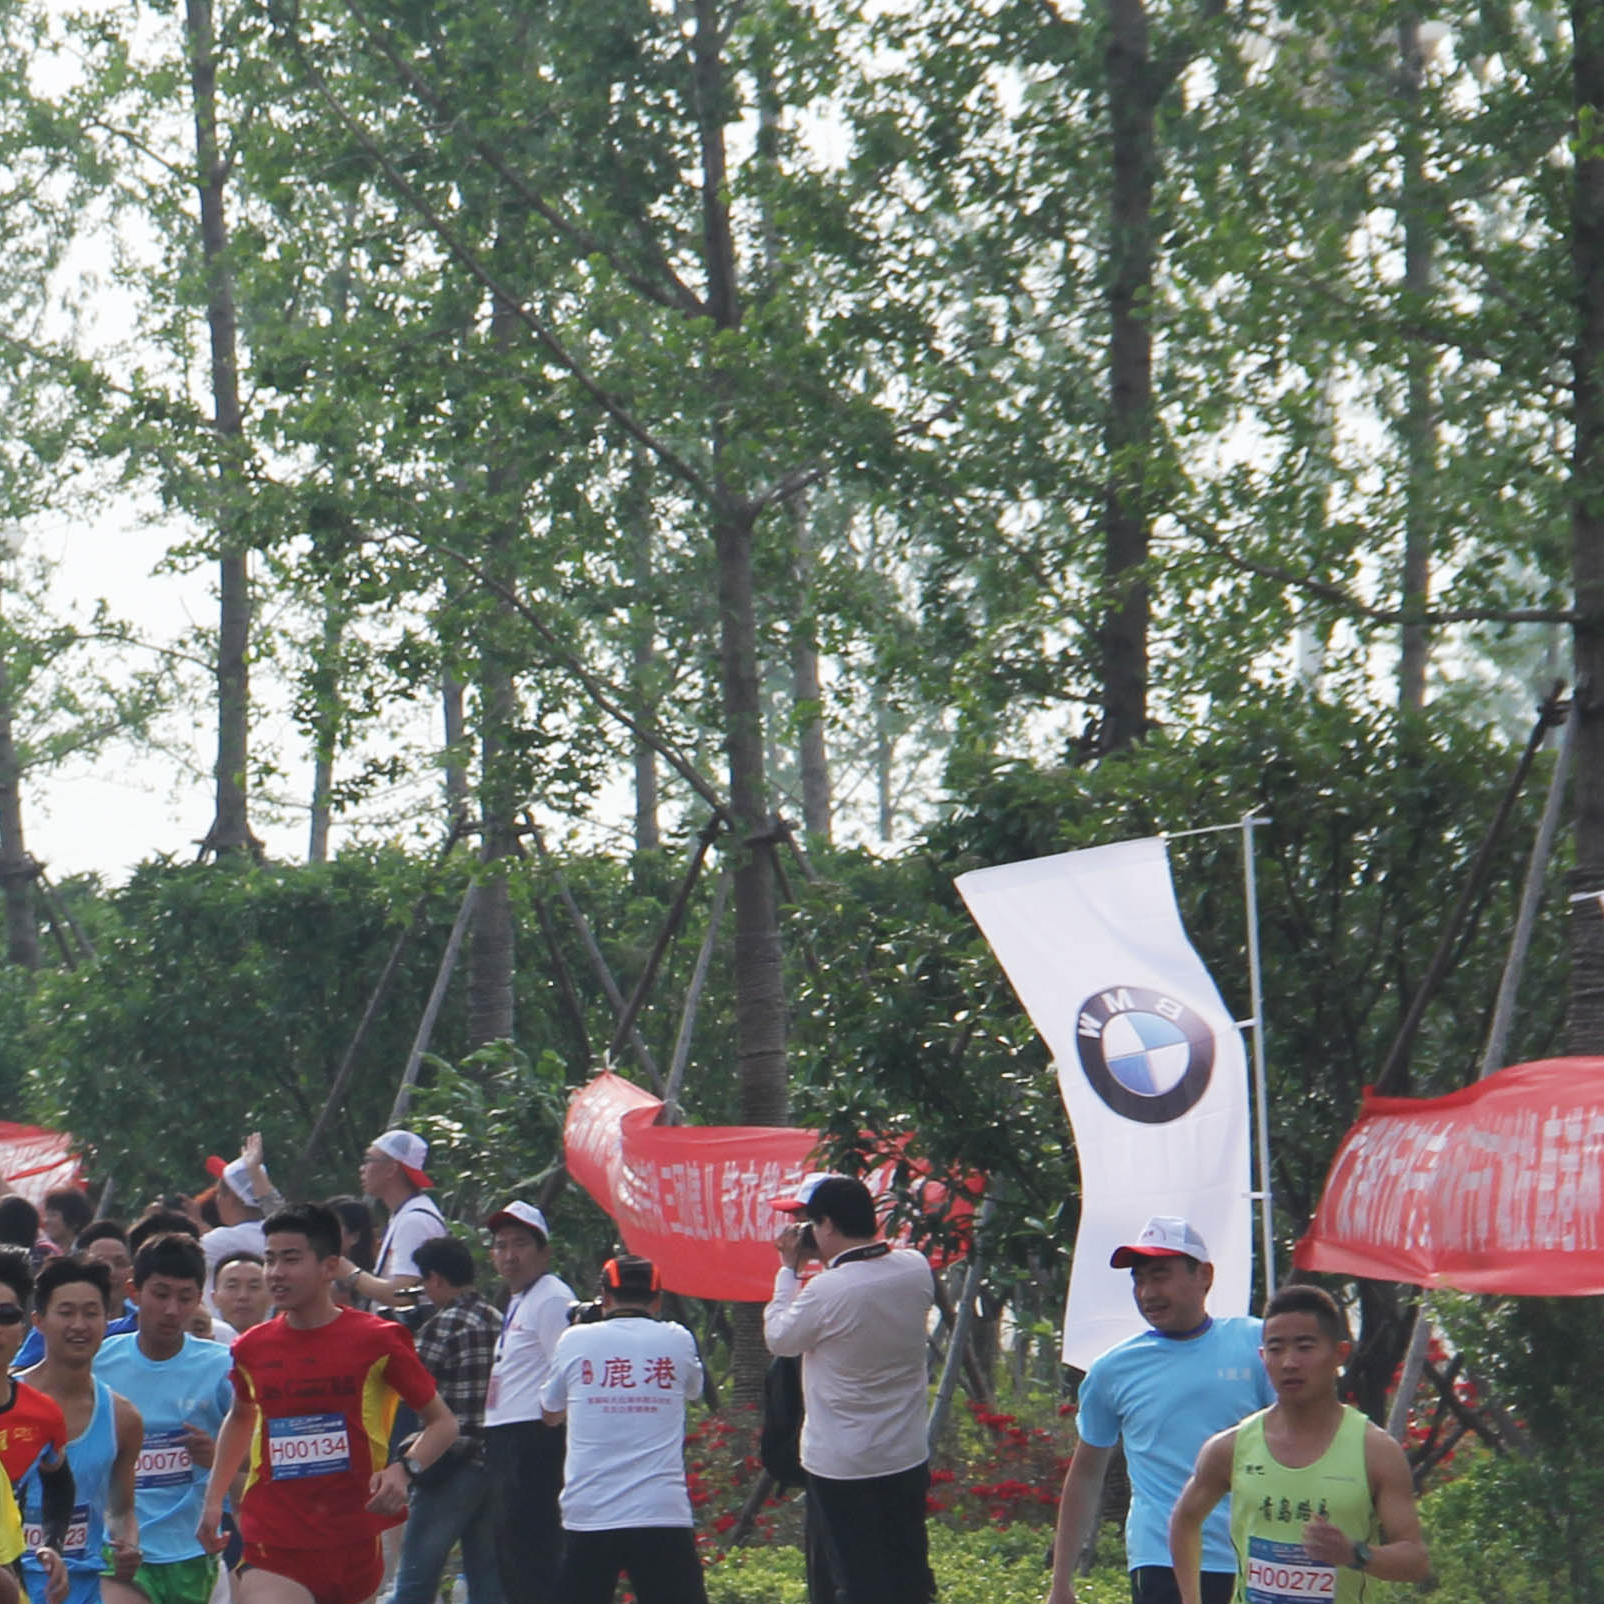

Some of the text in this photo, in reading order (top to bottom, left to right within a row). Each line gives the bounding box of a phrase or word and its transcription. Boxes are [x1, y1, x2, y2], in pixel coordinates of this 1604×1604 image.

[600, 1356, 677, 1390] 鹿港
[272, 1437, 347, 1461] H00134
[1248, 1562, 1335, 1593] H00272
